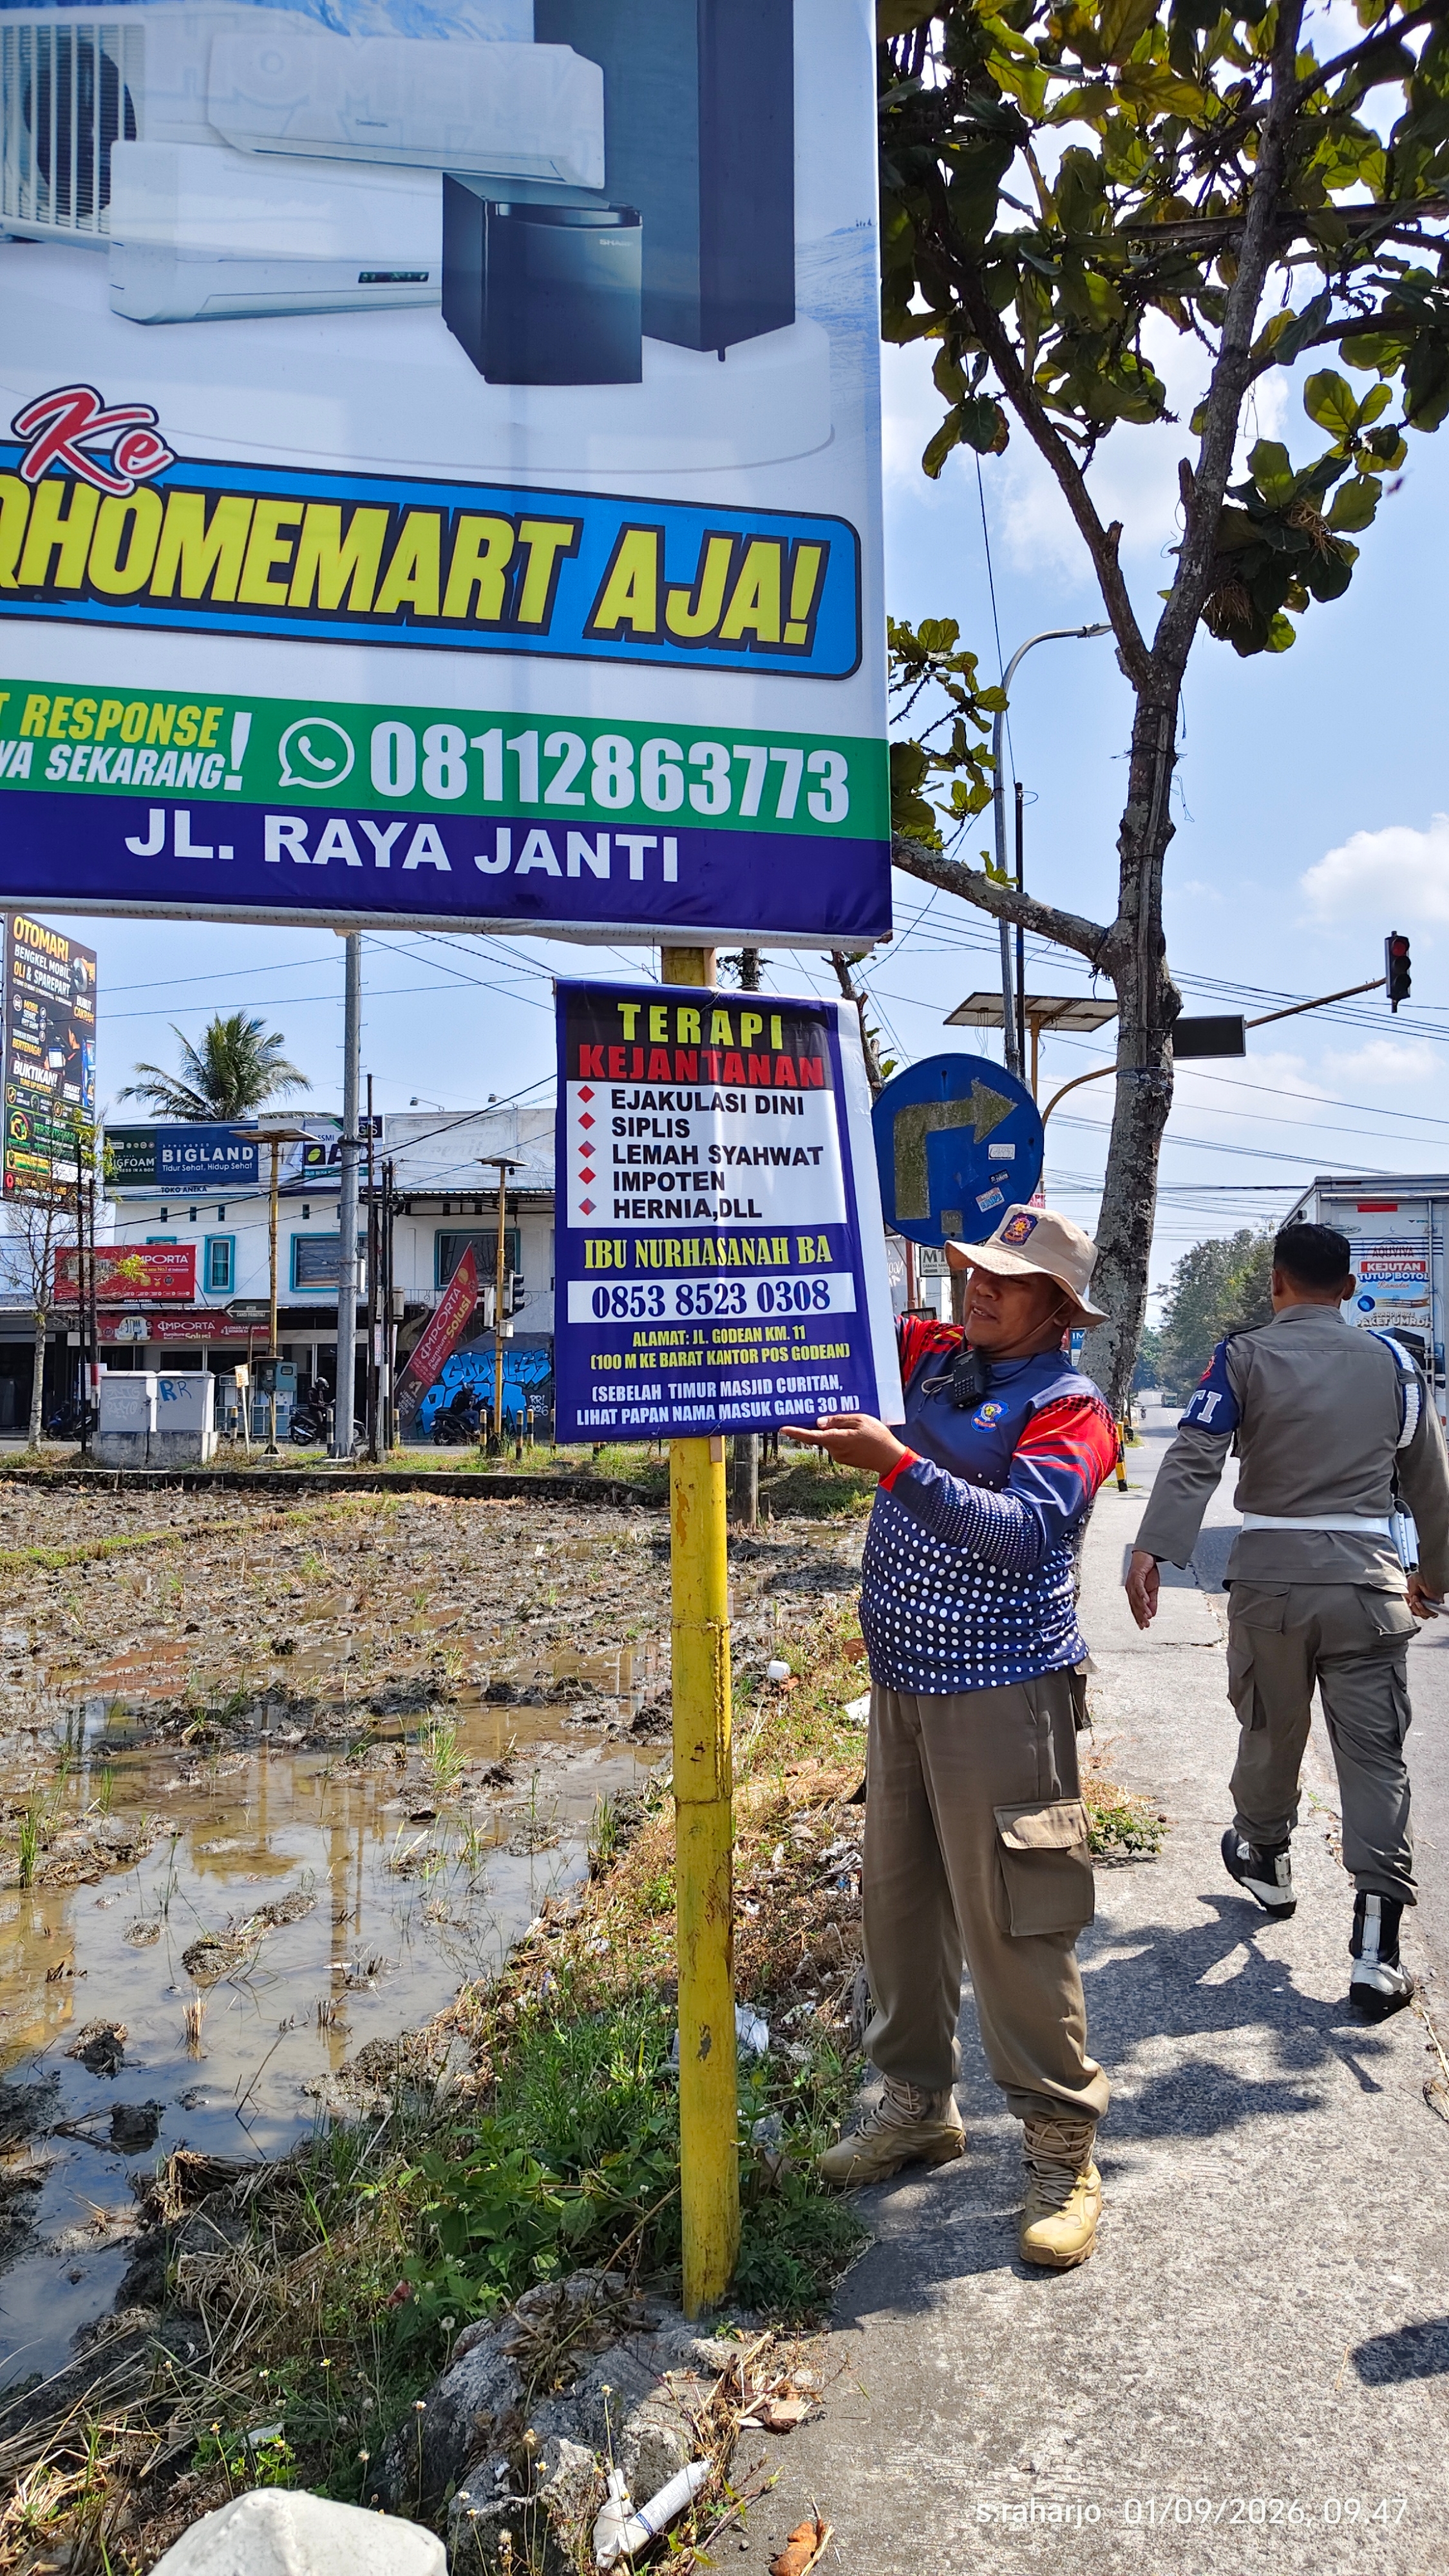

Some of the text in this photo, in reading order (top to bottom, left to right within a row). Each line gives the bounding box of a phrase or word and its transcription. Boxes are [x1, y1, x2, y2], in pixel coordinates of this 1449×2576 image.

[13, 386, 175, 495] Ke
[593, 530, 830, 645] AJA!
[19, 694, 223, 748] RESPONSE
[370, 720, 849, 823] 08112863773
[125, 808, 679, 883] JL. RAYA JANTI
[14, 916, 69, 963] OTOMARI
[14, 944, 48, 970] BENGKEL
[14, 960, 26, 978] OLI
[26, 966, 32, 982] &
[33, 969, 71, 998] SPAREPART
[617, 1003, 782, 1050] TERAPI
[13, 1060, 58, 1087] BUKTIKAN!
[580, 1044, 824, 1087] KEJANTANAN
[611, 1089, 804, 1115] EJAKULASI DINI
[611, 1117, 690, 1138] SIPLIS
[162, 1146, 254, 1163] BIGLAND
[231, 1161, 252, 1170] Sehat
[612, 1145, 824, 1166] LEMAH SYAHWAT
[613, 1171, 725, 1192] IMPOTEN
[613, 1198, 763, 1222] HERNIA,DLL
[583, 1236, 833, 1269] IBU NURHASANAH BA
[1358, 1272, 1430, 1281] TUTUP BOTOL
[1367, 1262, 1421, 1272] KEJUTAN
[591, 1279, 831, 1319] 0853 8523 0308
[1377, 1281, 1410, 1289] Ramadan
[446, 1294, 471, 1339] Solusi
[1354, 1317, 1390, 1328] PAKET
[632, 1325, 806, 1348] ALAMAT: JL. GODEAN KM. 11
[590, 1343, 851, 1371] (100 M KE BARAT KANTOR POS GODEAN)
[591, 1374, 844, 1403] (SEBELAH TIMUR MASJID CURITAN,
[576, 1394, 860, 1427] LIHAT PAPAN NAMA MASUK GANG 30 M)
